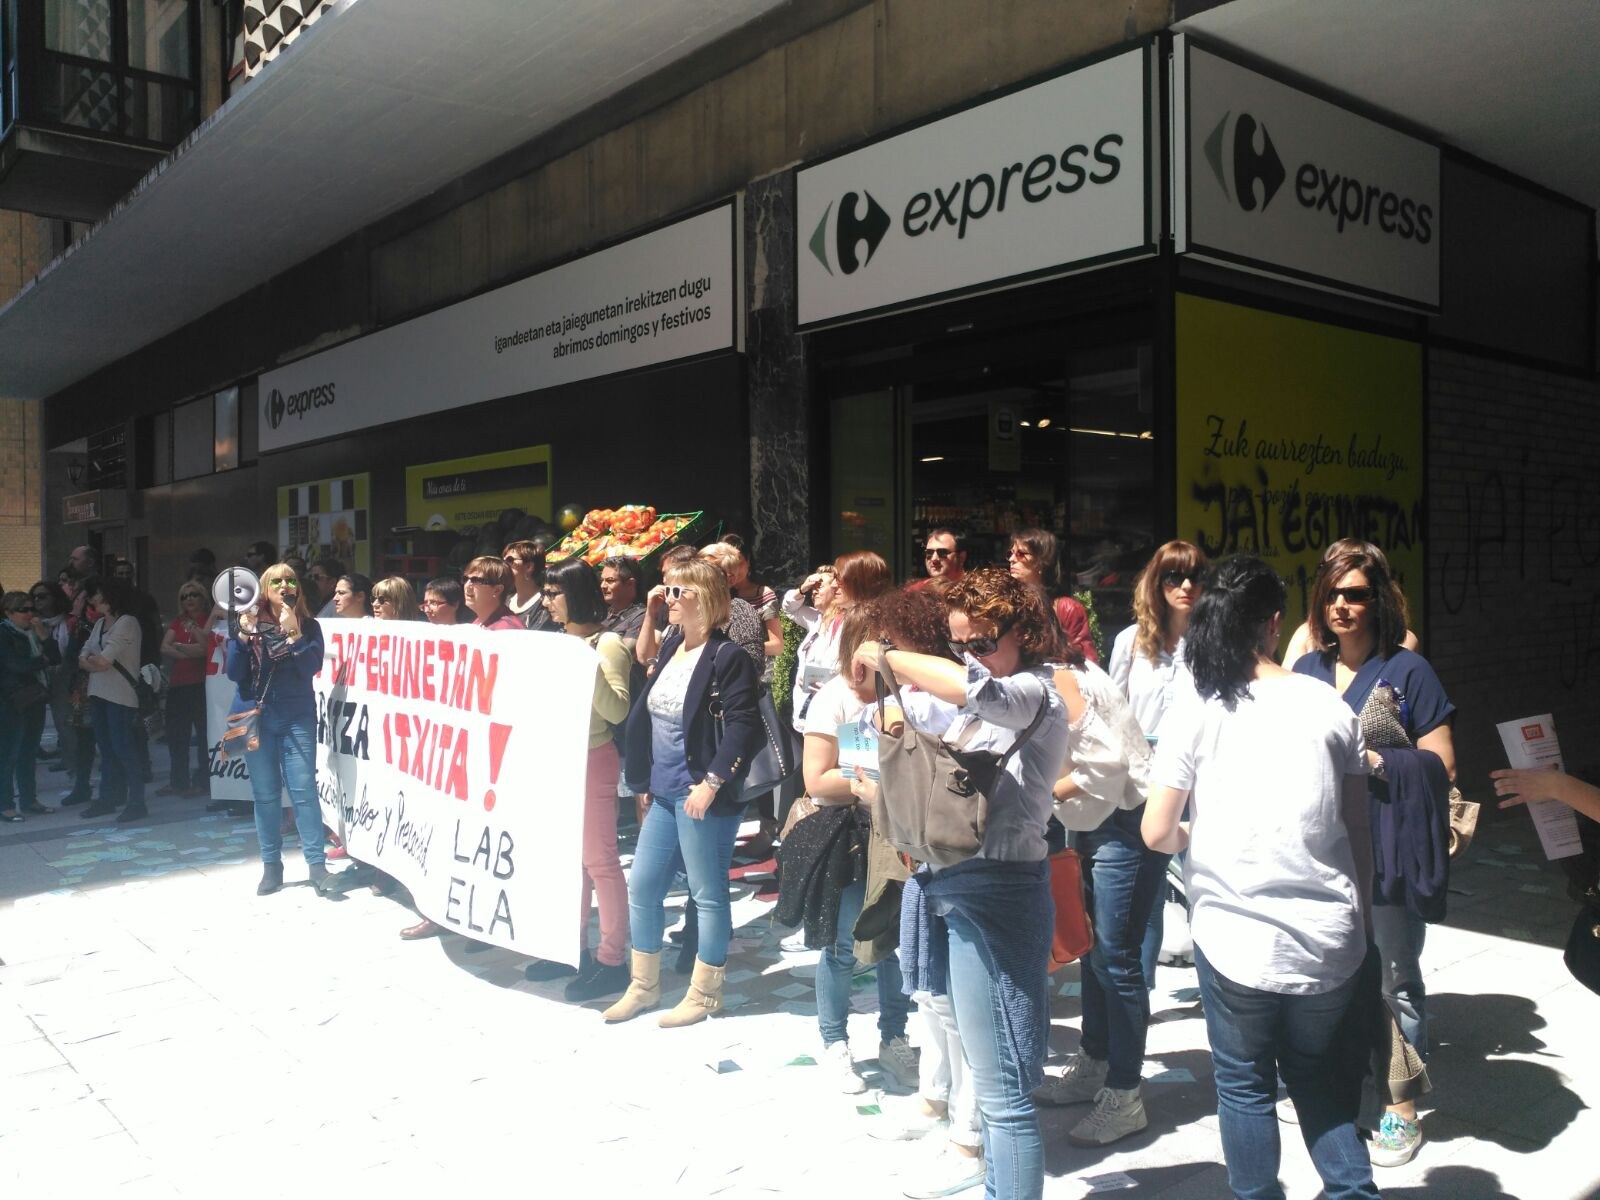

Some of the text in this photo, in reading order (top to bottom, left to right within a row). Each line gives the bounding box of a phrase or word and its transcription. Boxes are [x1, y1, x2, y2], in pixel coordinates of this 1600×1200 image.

[903, 133, 1124, 240] express
[1295, 162, 1433, 245] express
[494, 276, 711, 354] igandeetan eta jaiegunetan irekitzen dugu
[553, 304, 711, 359] abrimos domingos y festivos
[287, 381, 336, 421] express
[1203, 414, 1249, 459] Zuk
[1254, 433, 1343, 474] aurrezten
[316, 691, 371, 761] RITZA
[209, 741, 249, 780] tura
[454, 818, 515, 880] LAB
[446, 876, 515, 941] ELA
